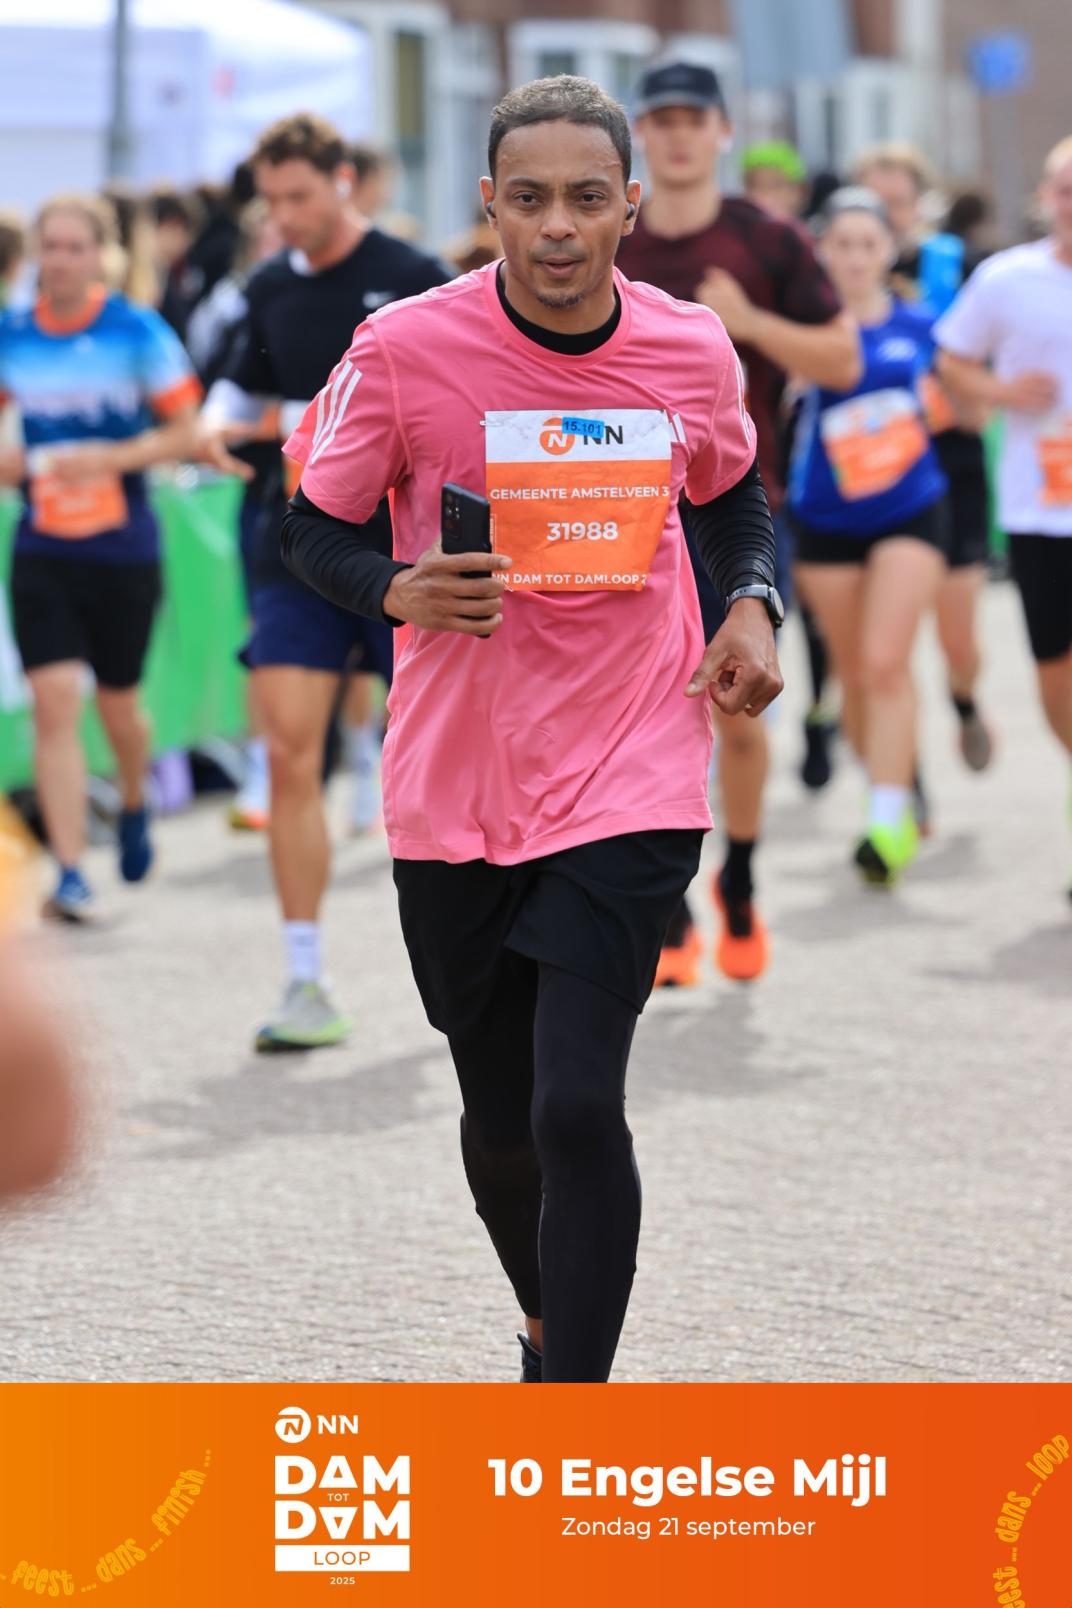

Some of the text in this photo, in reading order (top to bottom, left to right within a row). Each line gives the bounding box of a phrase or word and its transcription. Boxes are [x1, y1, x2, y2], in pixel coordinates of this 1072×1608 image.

[490, 486, 670, 501] GEMEENTE AMSTELVEEN 3
[546, 521, 619, 541] 31988
[513, 573, 542, 584] DAM
[545, 574, 571, 584] TOT
[574, 574, 639, 585] DAMLOOP
